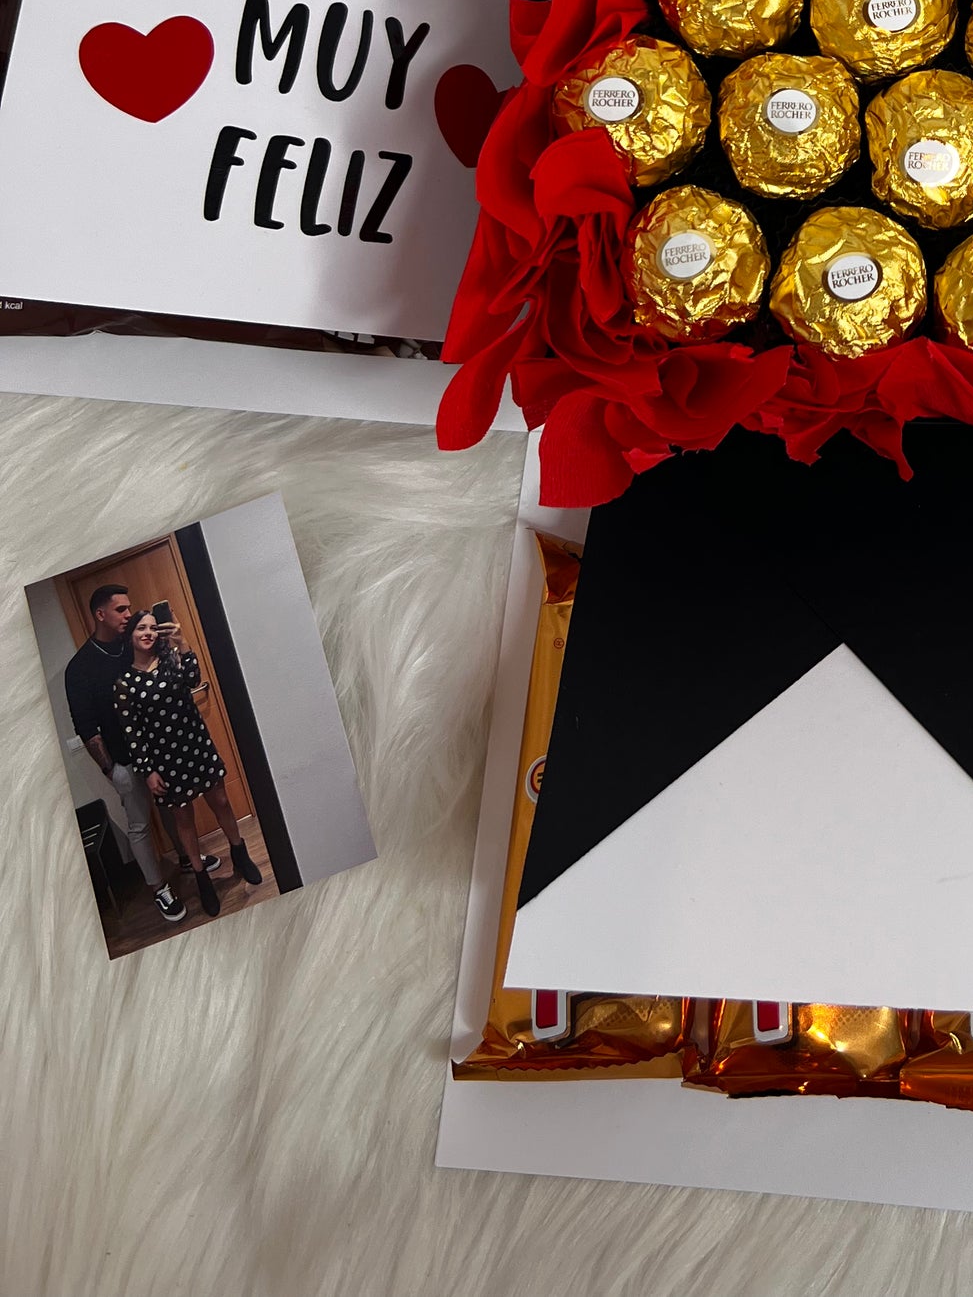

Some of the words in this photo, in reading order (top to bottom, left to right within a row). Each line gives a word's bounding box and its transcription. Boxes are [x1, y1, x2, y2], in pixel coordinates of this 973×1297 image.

[872, 7, 913, 20] ROCHER
[592, 89, 635, 99] FERRERO
[592, 98, 634, 108] ROCHER
[771, 101, 812, 111] FERRERO
[771, 110, 812, 119] ROCHER
[203, 125, 413, 245] FELIZ
[664, 243, 706, 256] FERRERO
[665, 252, 707, 266] ROCHER
[831, 264, 873, 279] FERRERO
[832, 274, 875, 289] ROCHER
[4, 301, 23, 310] kcal
